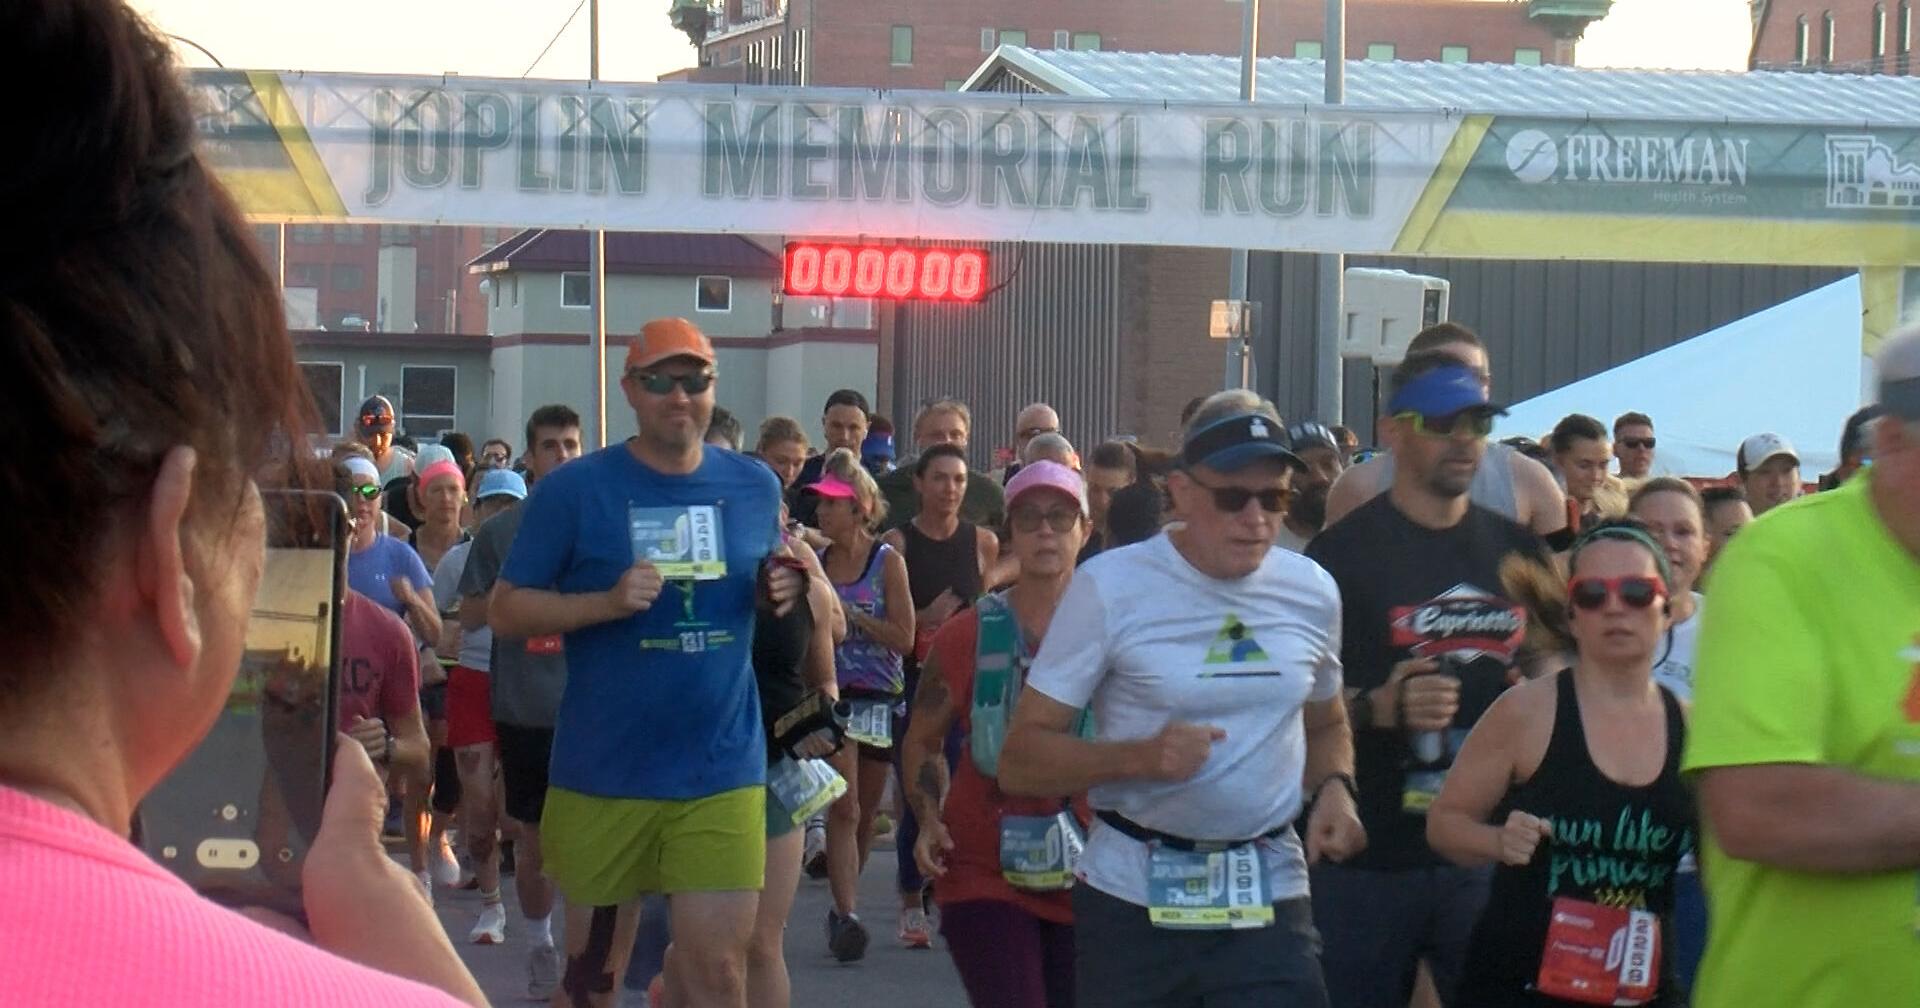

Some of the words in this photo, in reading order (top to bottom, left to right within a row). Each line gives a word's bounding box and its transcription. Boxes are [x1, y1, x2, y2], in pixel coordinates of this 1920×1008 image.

[364, 89, 647, 207] JOPLIN
[703, 101, 1151, 211] MEMORIAL
[1201, 116, 1374, 219] RUN
[1563, 134, 1750, 186] FREEMAN
[1653, 188, 1697, 202] Health
[1702, 190, 1747, 206] System
[791, 246, 981, 298] 000000
[1613, 804, 1675, 858] like
